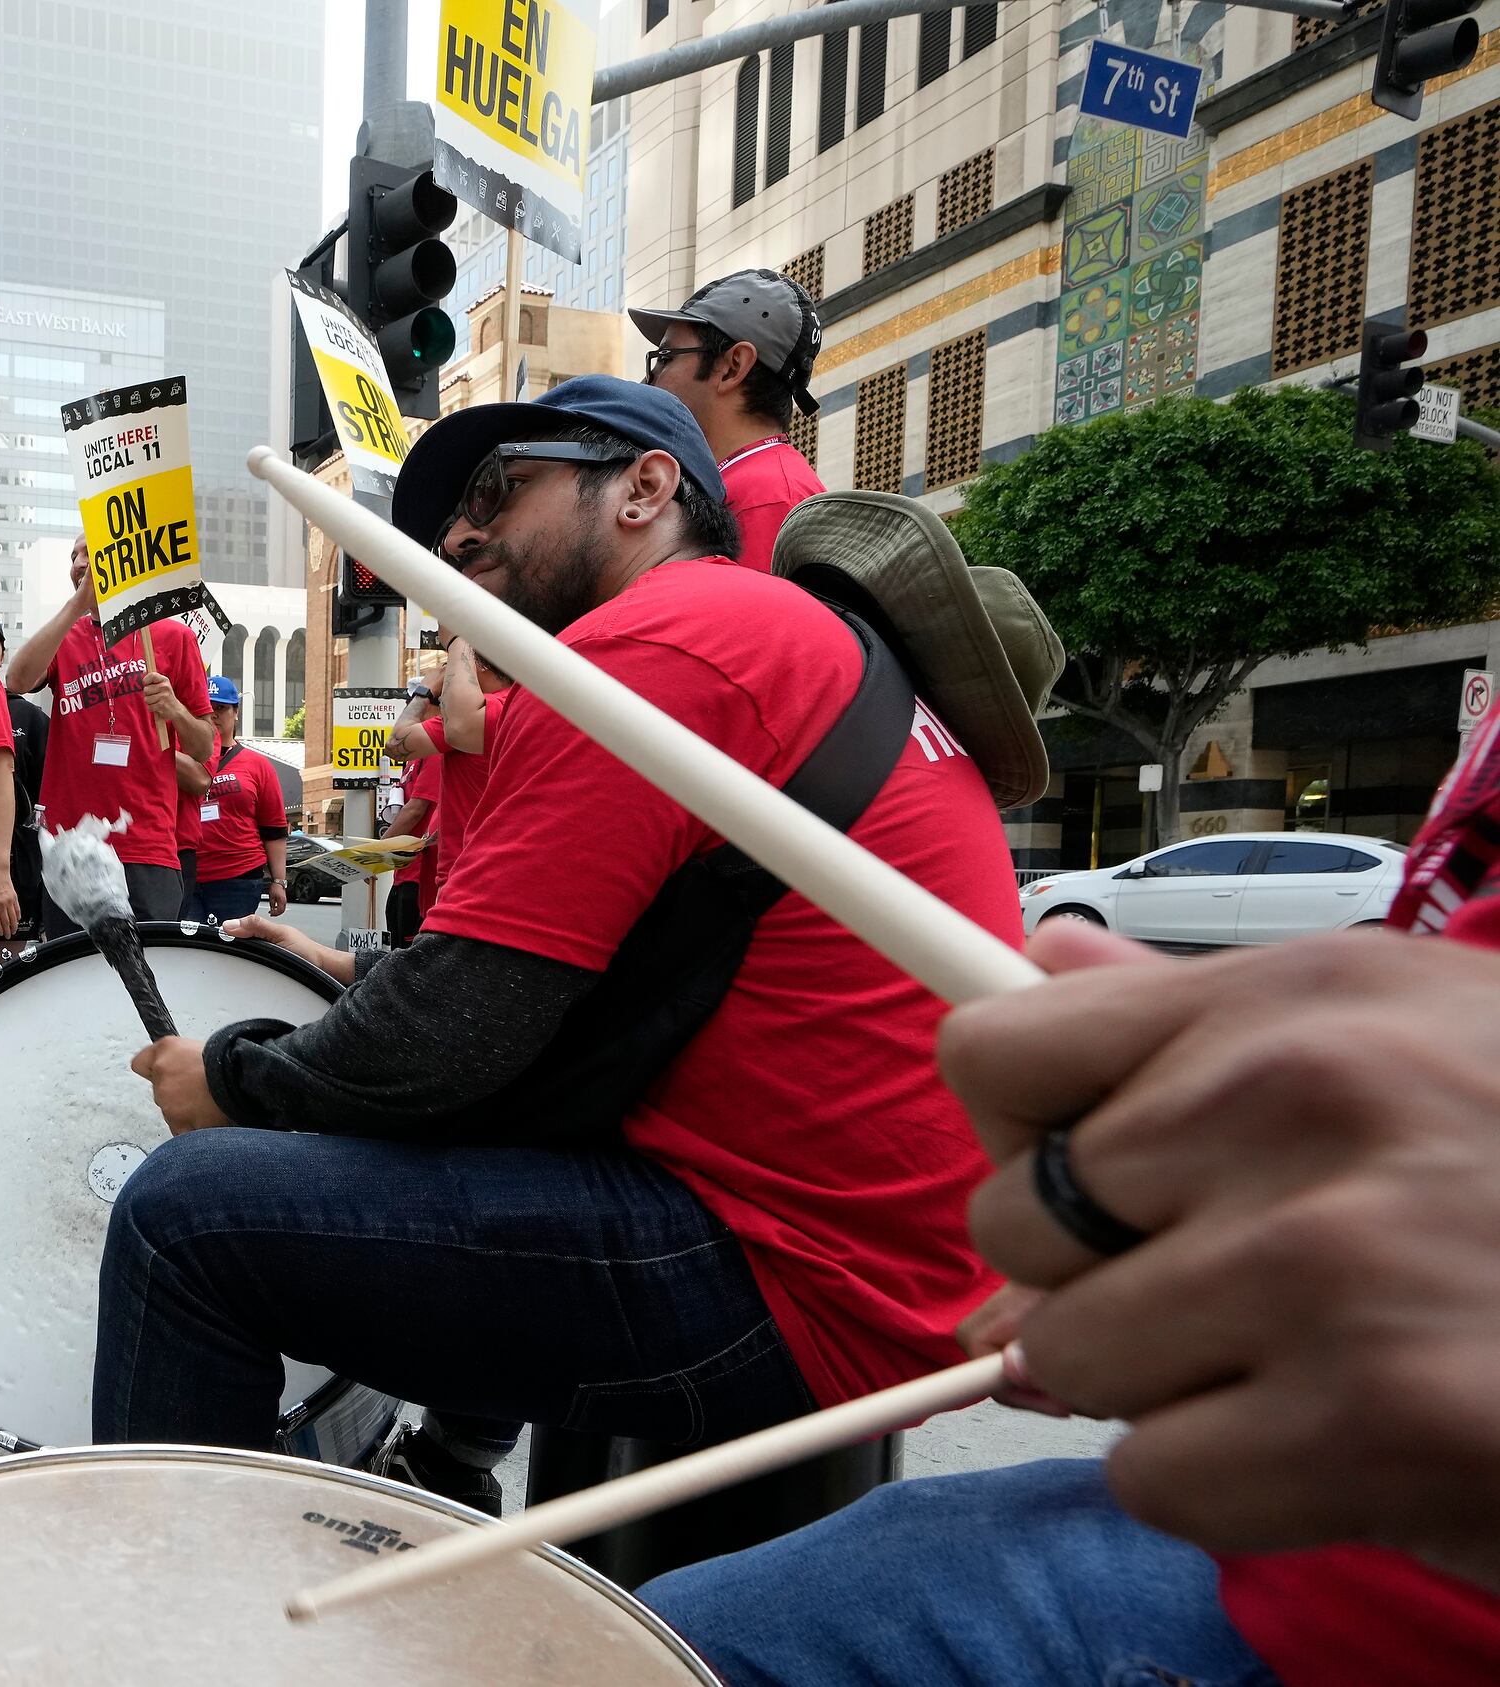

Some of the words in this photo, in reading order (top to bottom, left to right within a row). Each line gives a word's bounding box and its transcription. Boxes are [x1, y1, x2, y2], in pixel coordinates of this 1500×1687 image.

[501, 0, 552, 77] EN
[443, 23, 582, 178] HUELGA
[1102, 57, 1146, 106] 7th
[1149, 76, 1182, 118] St
[355, 373, 394, 427] ON
[1420, 387, 1433, 404] DO
[1436, 390, 1454, 409] NOT
[84, 435, 115, 459] UNITE
[117, 424, 159, 448] HERE!
[86, 448, 135, 480] LOCAL
[142, 441, 162, 461] 11
[106, 487, 148, 541] ON
[94, 519, 192, 595] STRIKE
[79, 659, 148, 689] WORKERS
[59, 694, 83, 717] ON
[348, 712, 382, 720] LOCAL
[386, 712, 396, 720] 11
[358, 729, 385, 749] ON
[337, 748, 406, 768] STRI
[1190, 815, 1228, 835] 660
